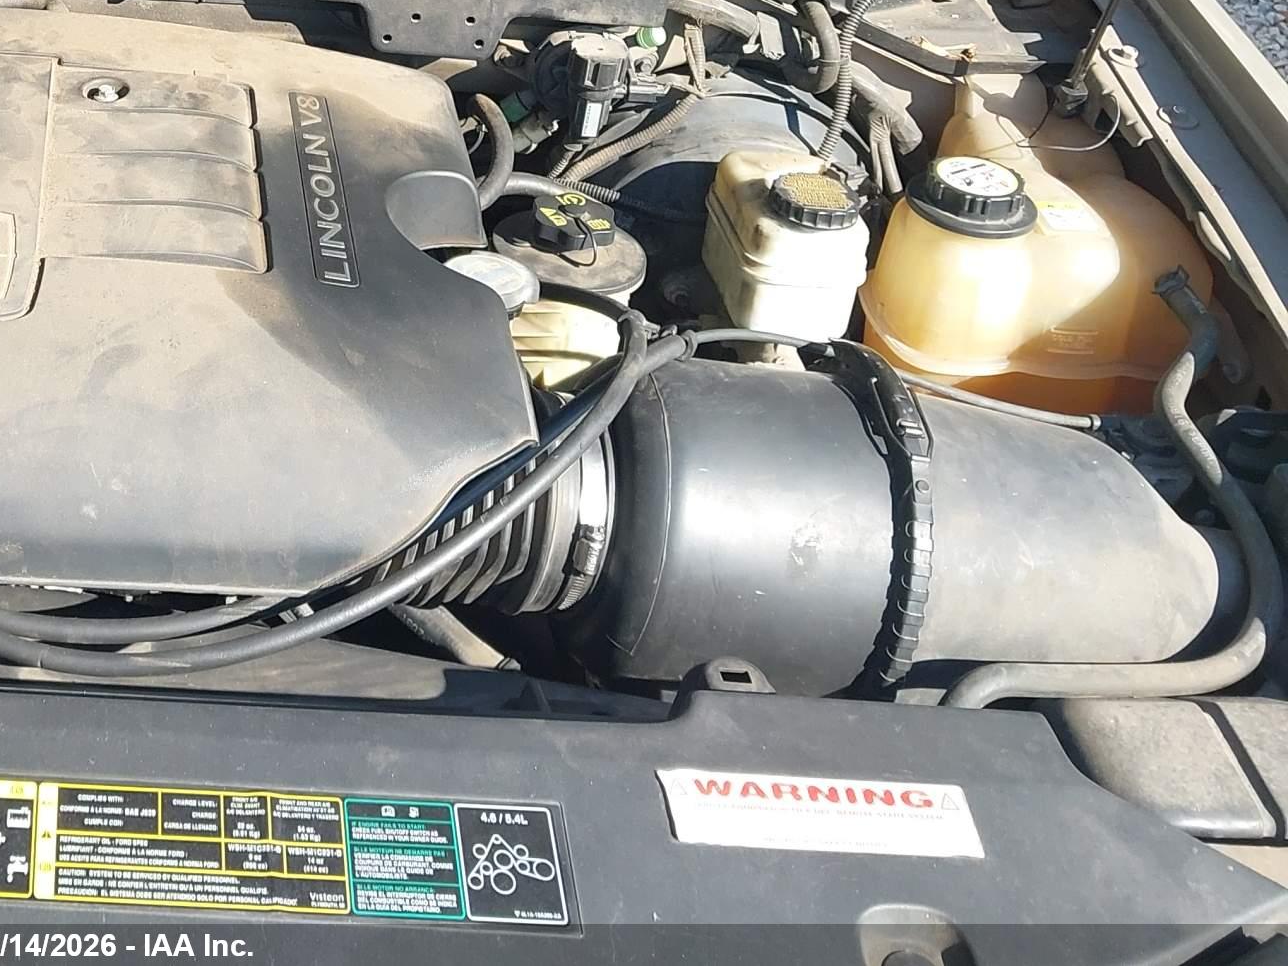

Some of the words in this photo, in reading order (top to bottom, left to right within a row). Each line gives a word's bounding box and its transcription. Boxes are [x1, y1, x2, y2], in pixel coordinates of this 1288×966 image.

[296, 95, 322, 126] V8
[302, 134, 352, 282] LINCOLN
[693, 779, 933, 808] WARNING
[481, 812, 497, 824] 4.6
[310, 892, 344, 901] Visteon
